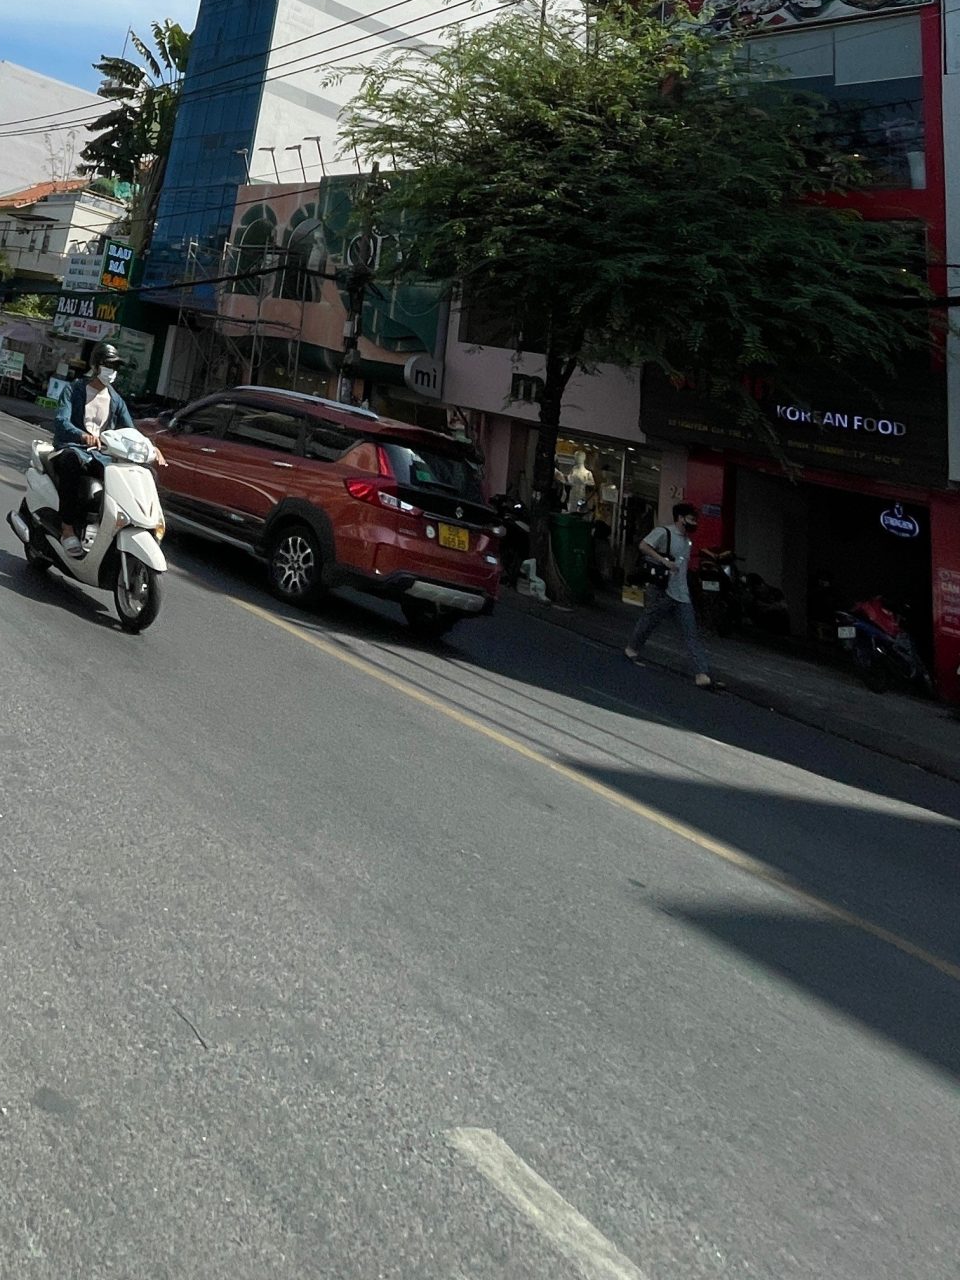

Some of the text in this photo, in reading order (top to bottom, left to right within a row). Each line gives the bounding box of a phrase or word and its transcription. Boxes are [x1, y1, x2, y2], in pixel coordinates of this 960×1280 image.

[108, 244, 132, 260] RAU
[57, 296, 117, 320] RAU MÁ mix
[776, 404, 907, 437] KOREAN FOOD
